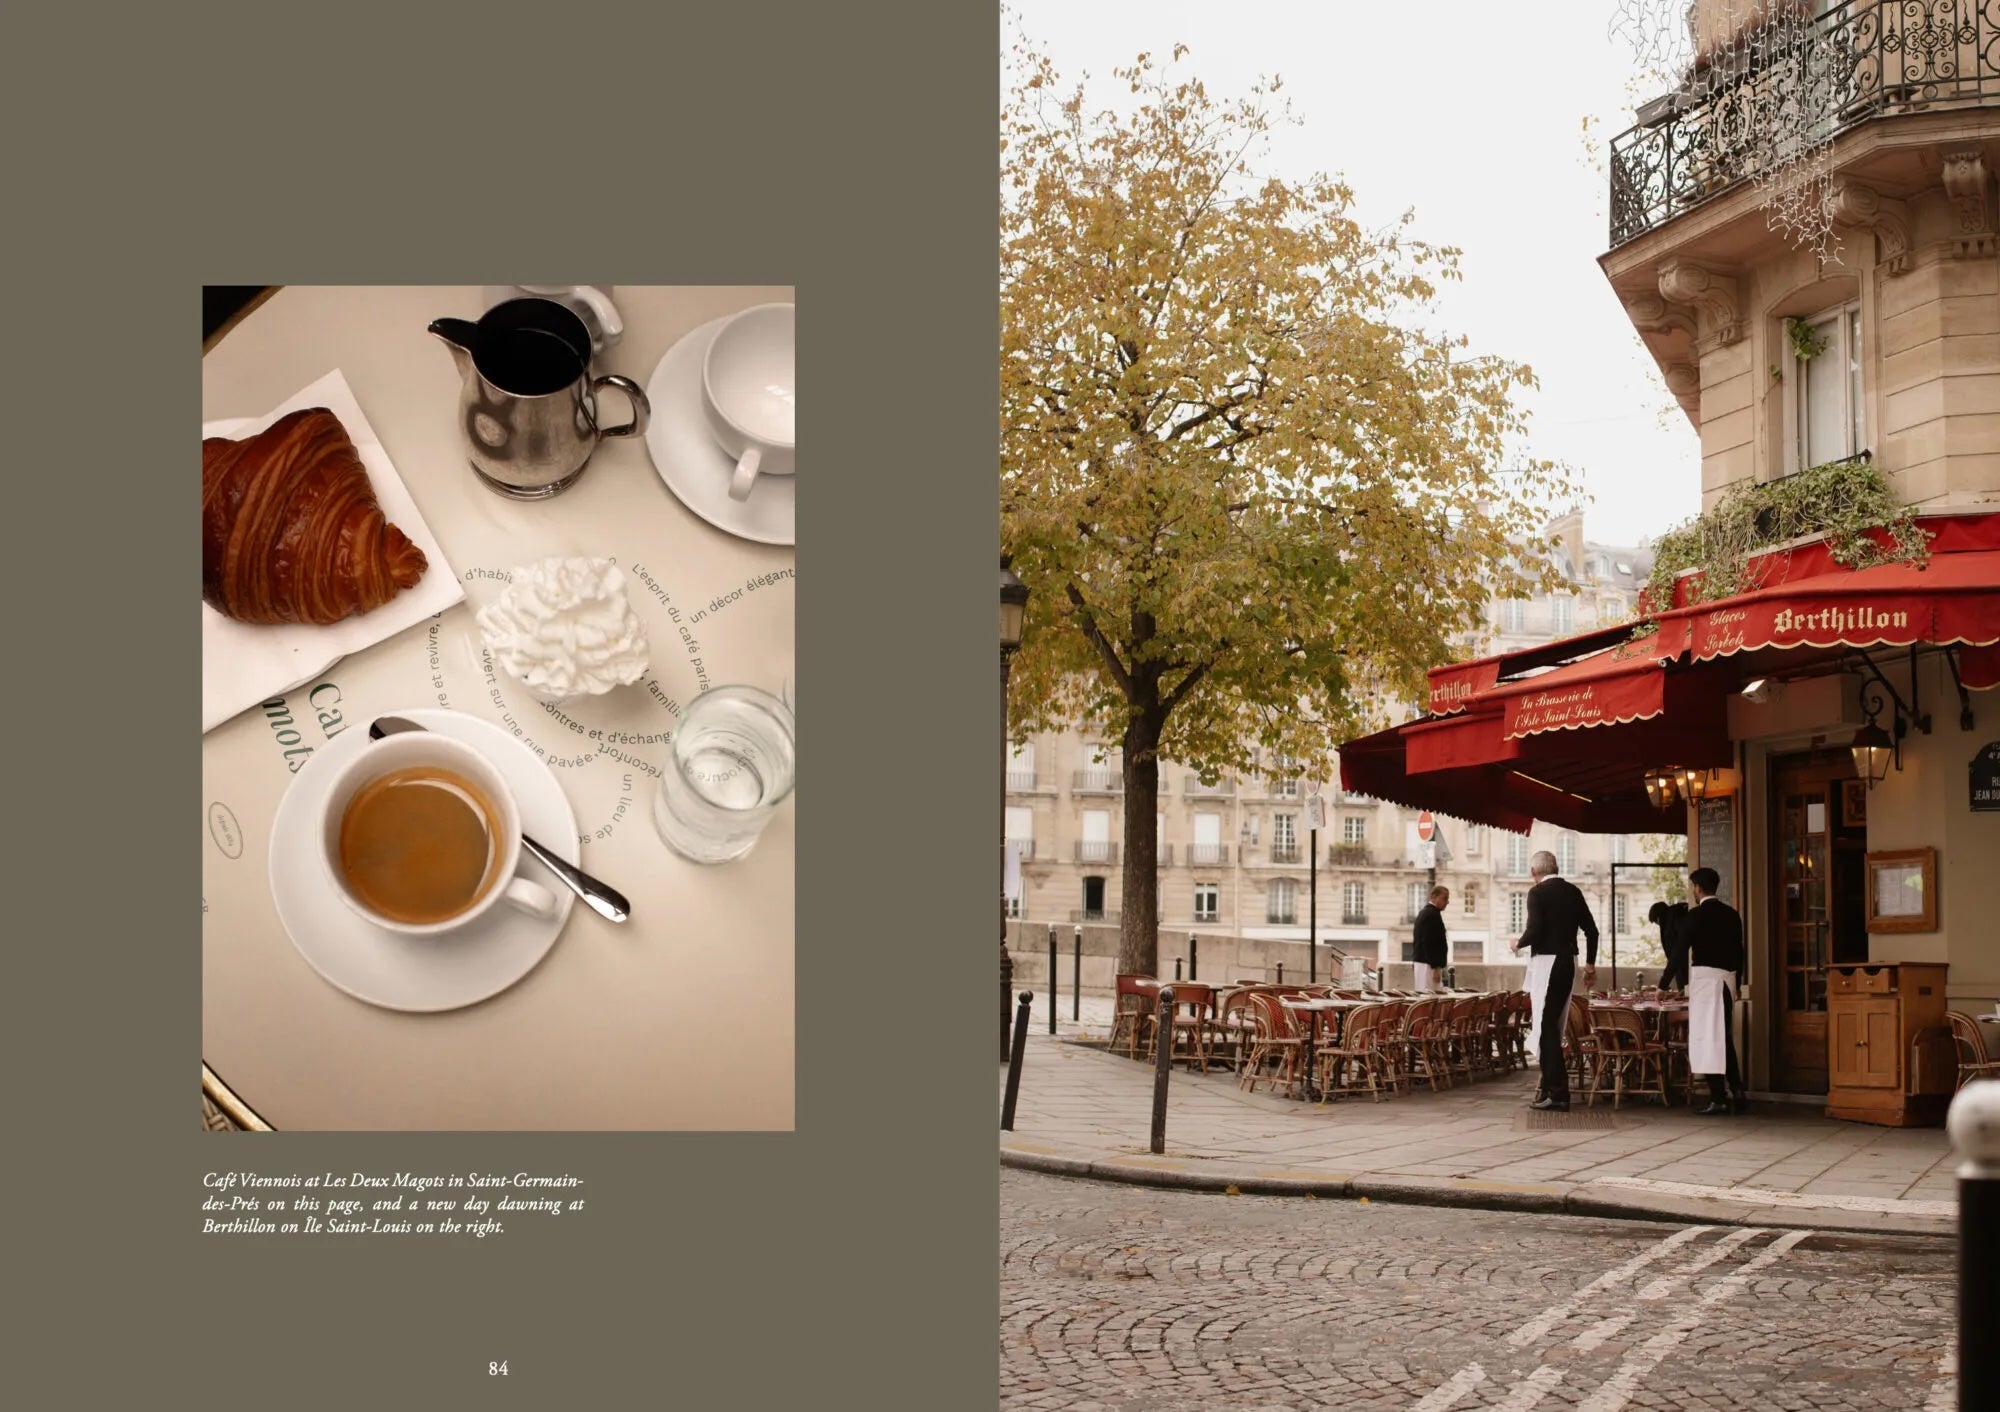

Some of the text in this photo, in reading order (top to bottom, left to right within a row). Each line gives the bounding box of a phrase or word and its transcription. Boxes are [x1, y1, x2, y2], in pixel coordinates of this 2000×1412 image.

[690, 568, 796, 623] un décor élégant
[632, 563, 711, 695] L'esprit du café paris
[1710, 609, 1746, 626] Glaces
[1774, 606, 1908, 635] Berthillon
[426, 623, 441, 670] revivre,
[432, 674, 444, 689] et
[438, 693, 451, 709] re
[1536, 691, 1580, 707] Brasserie
[1582, 685, 1593, 700] de
[490, 689, 507, 710] sur
[502, 713, 523, 737] une
[539, 701, 585, 734] ontres
[588, 729, 604, 741] et
[1542, 703, 1602, 723] Saint-Louis
[598, 743, 663, 778] réconfort
[622, 774, 633, 791] un
[1974, 790, 1990, 800] JEAN
[612, 796, 633, 822] lieu
[595, 824, 613, 839] de
